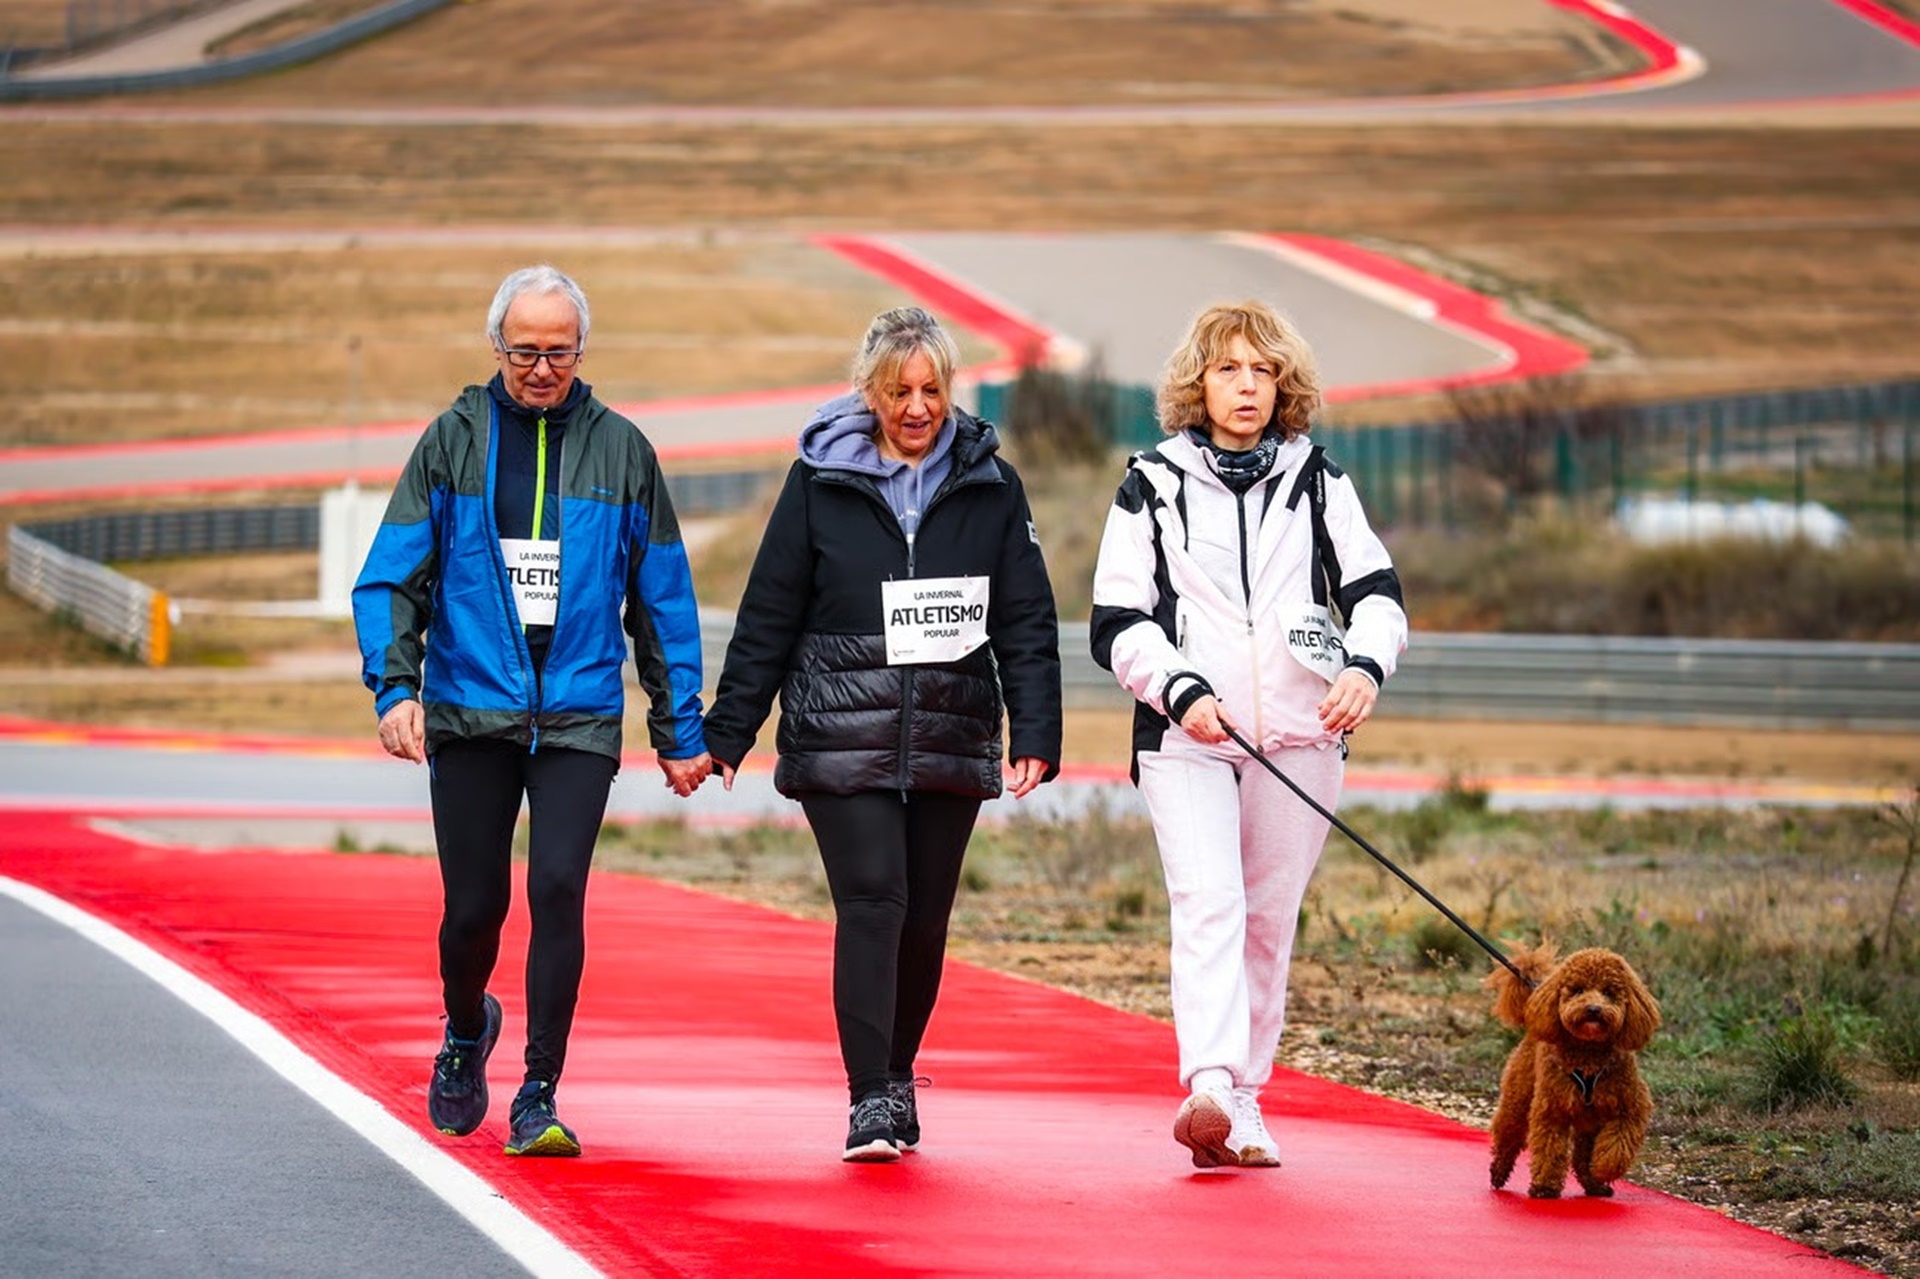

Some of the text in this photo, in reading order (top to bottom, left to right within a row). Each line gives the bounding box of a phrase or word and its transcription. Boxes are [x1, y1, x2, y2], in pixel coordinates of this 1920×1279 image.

[519, 552, 530, 561] LA
[914, 590, 964, 601] LA INVERNAL
[890, 604, 984, 626] ATLETISMO
[923, 628, 960, 639] POPULAR
